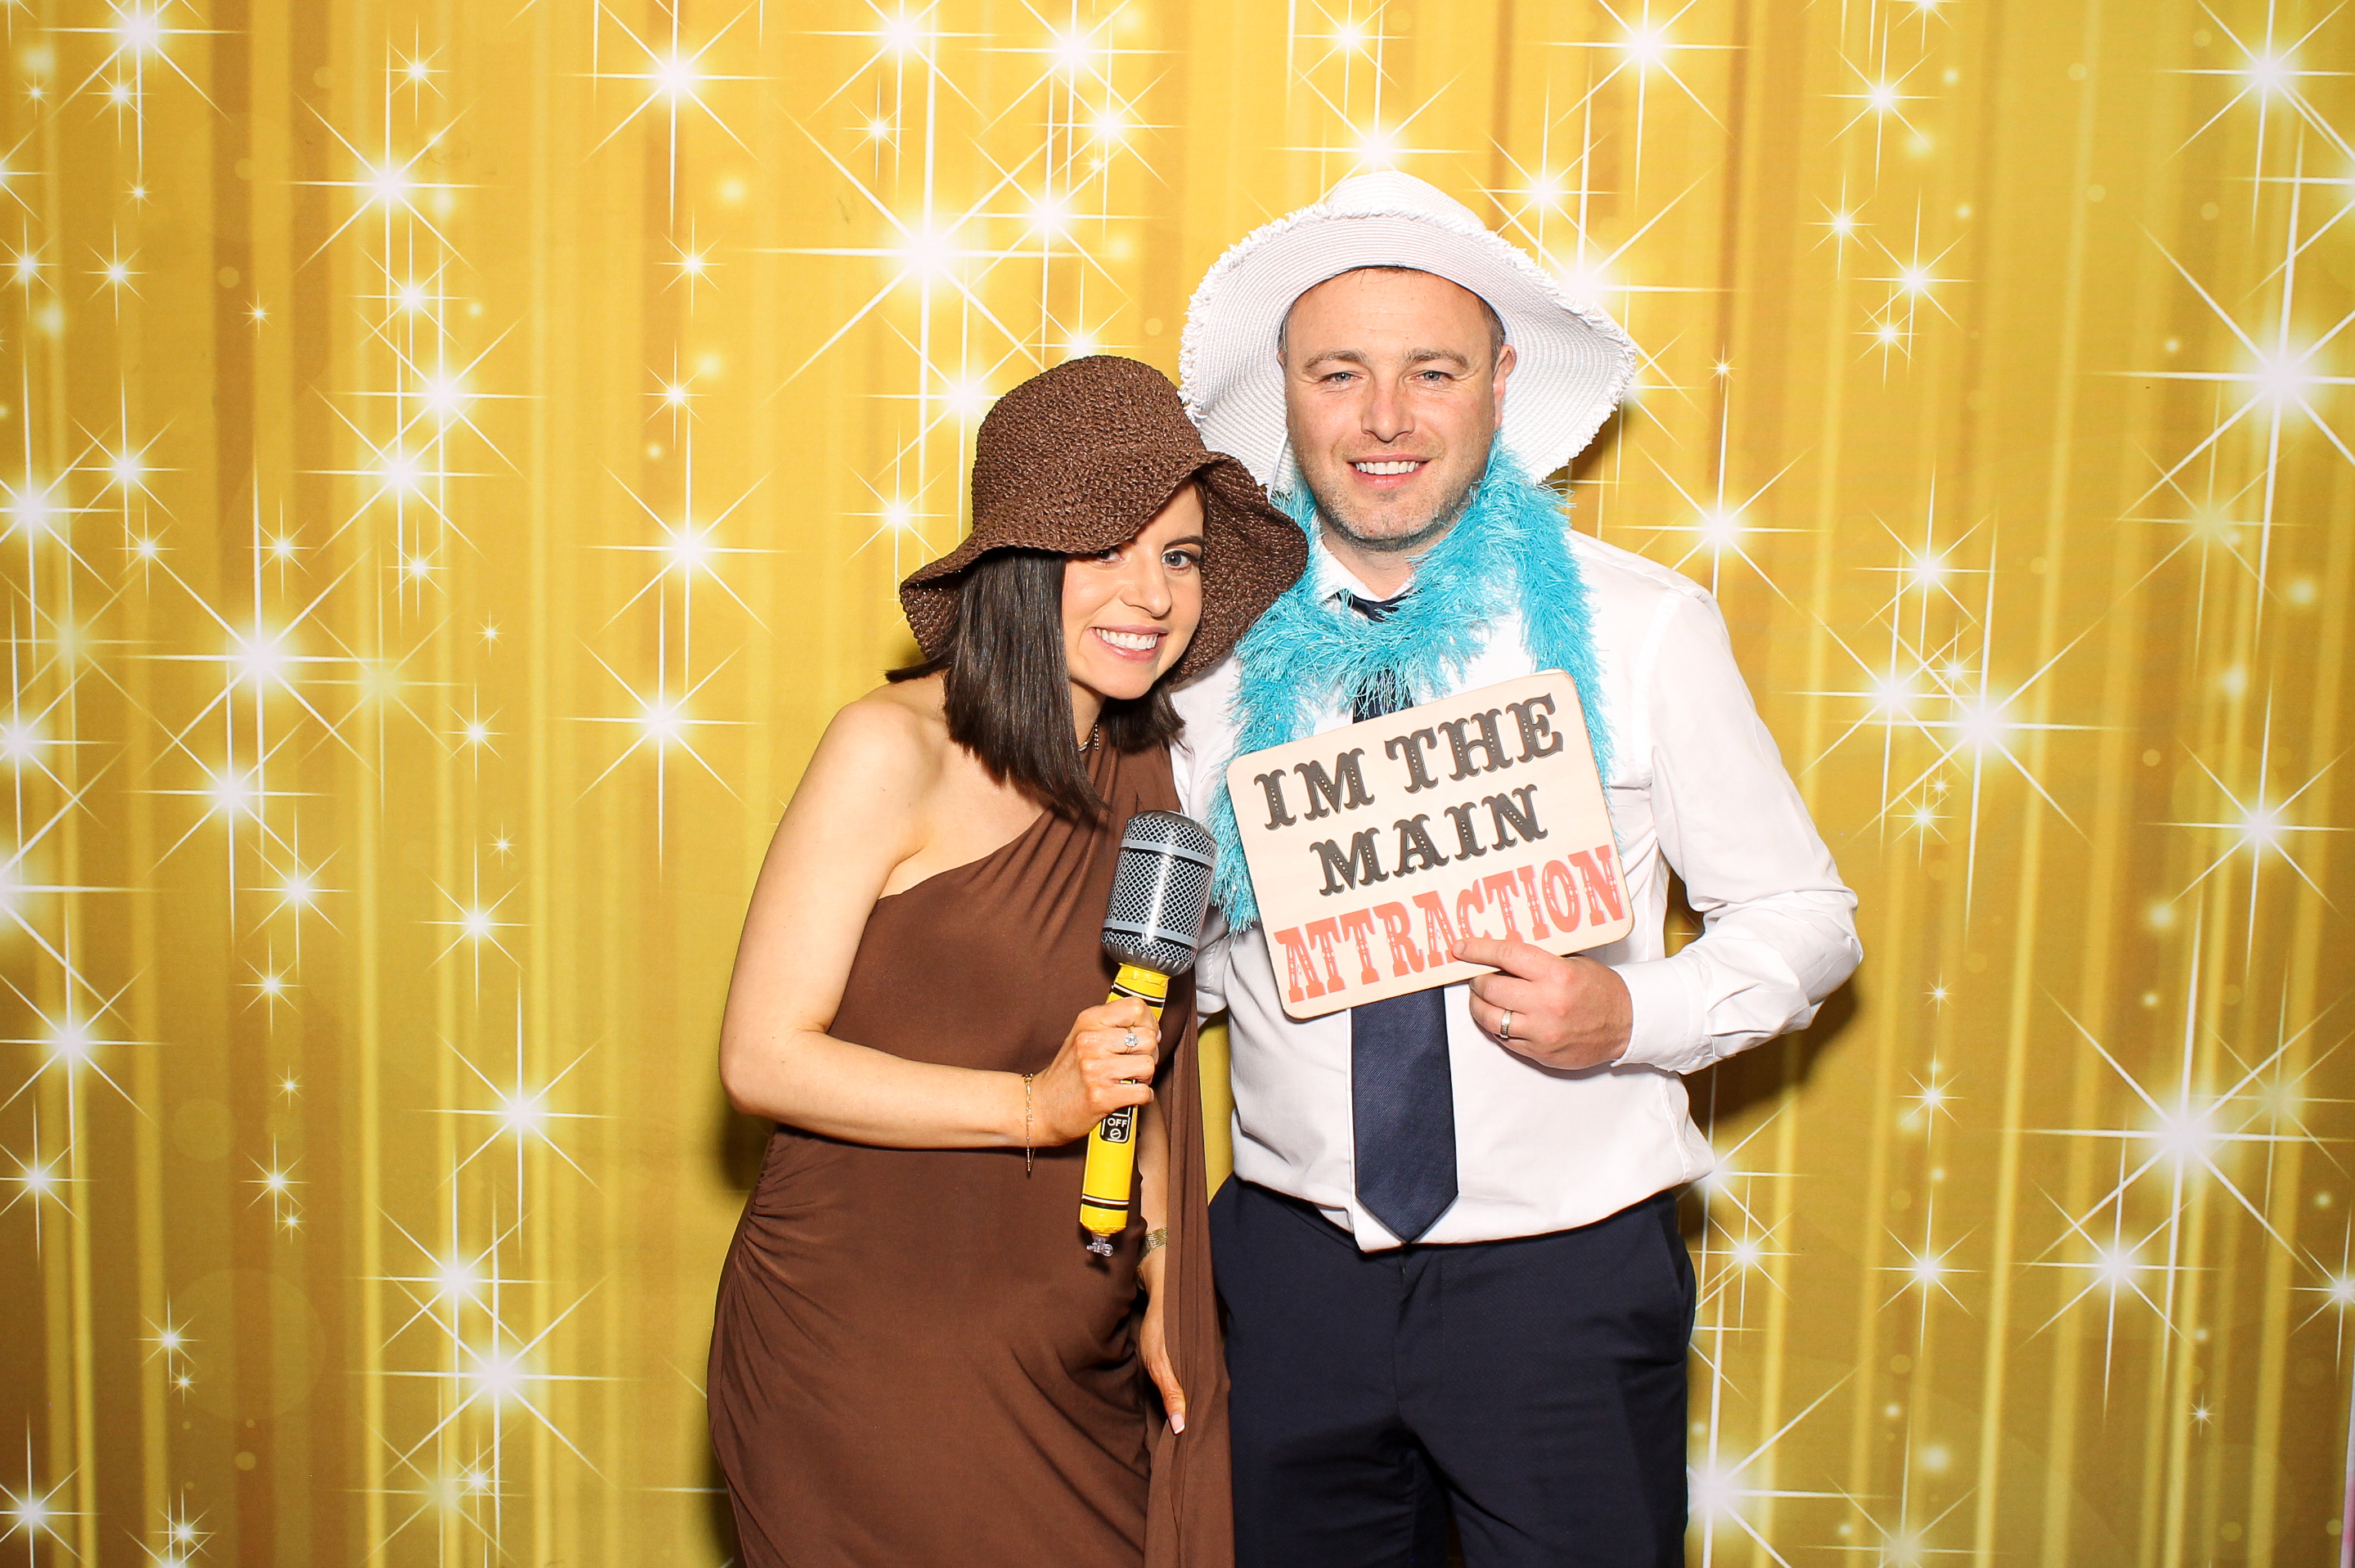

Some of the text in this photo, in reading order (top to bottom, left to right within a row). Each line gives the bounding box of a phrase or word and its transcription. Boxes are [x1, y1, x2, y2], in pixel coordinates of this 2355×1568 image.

[1254, 693, 1564, 830] IM THE
[1310, 784, 1548, 896] MAIN
[1274, 844, 1625, 1004] ATTRACTION
[1108, 1117, 1127, 1127] OFF
